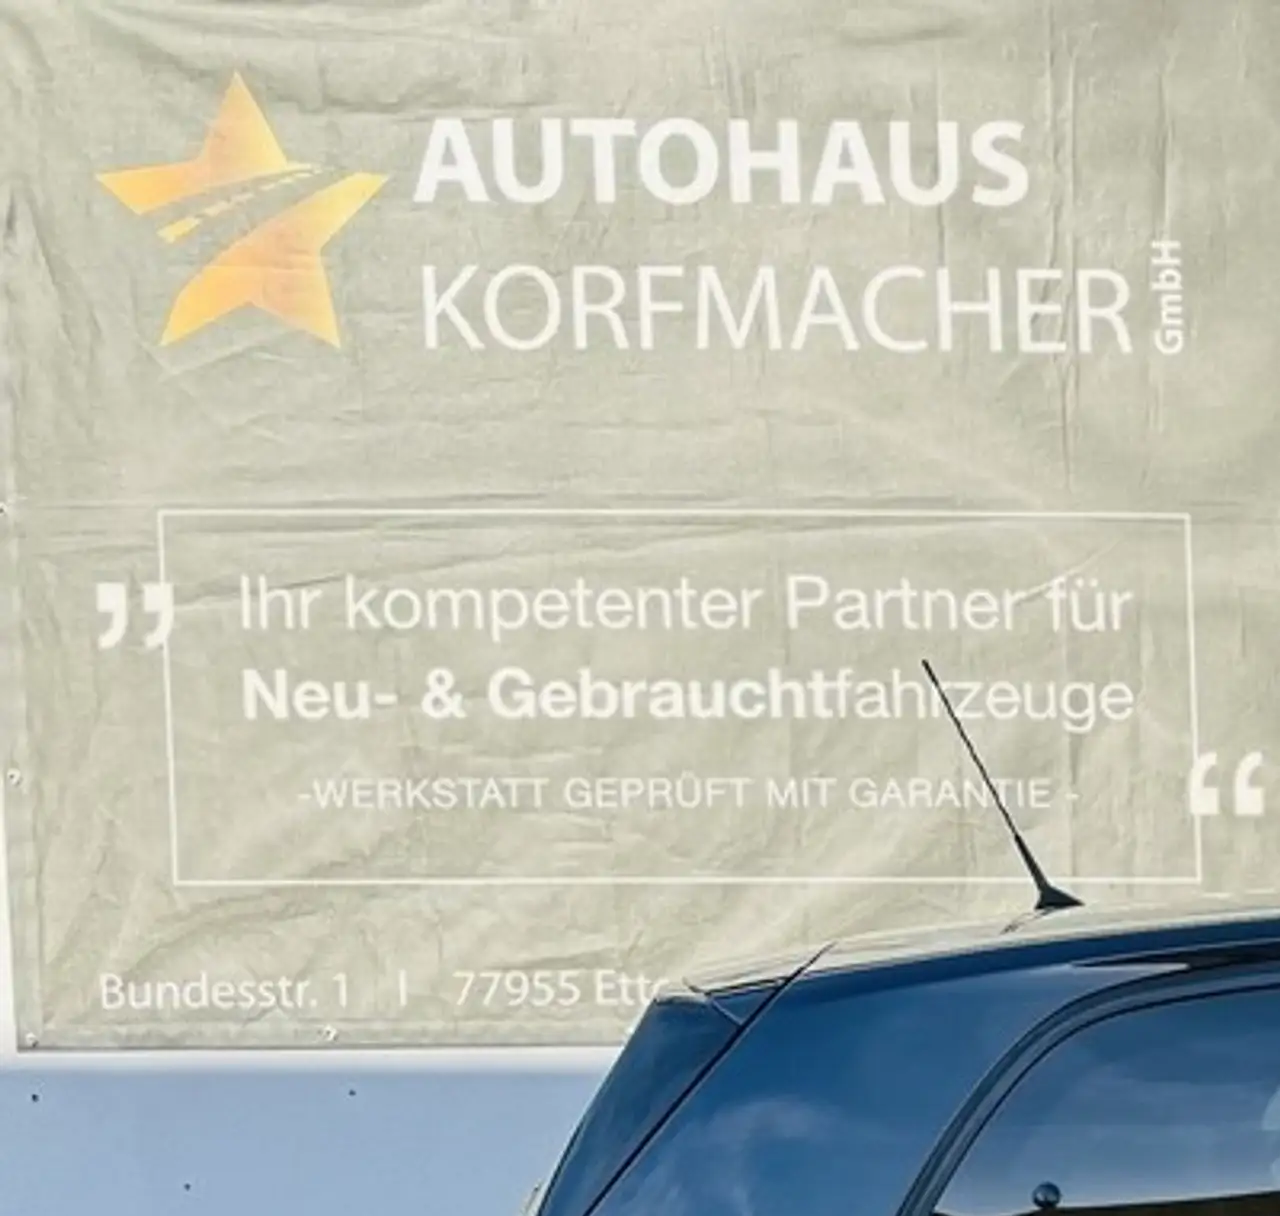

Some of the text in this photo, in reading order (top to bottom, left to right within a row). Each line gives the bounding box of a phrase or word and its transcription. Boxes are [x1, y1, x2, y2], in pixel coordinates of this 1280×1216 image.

[413, 116, 1030, 207] AUTOHAUS
[421, 264, 1133, 355] KORFMACHER
[1151, 240, 1184, 355] GmbH
[240, 573, 1134, 643] Ihr kompetenter Partner für
[242, 667, 1135, 733] Neu- & Gebrauchtfahrzeuge
[564, 772, 750, 809] GEPRÜFT
[768, 778, 837, 809] MIT
[849, 777, 1052, 809] GARANTIE
[100, 971, 317, 1009] Bundesstr.
[331, 973, 347, 1007] 1
[453, 969, 580, 1007] 77955
